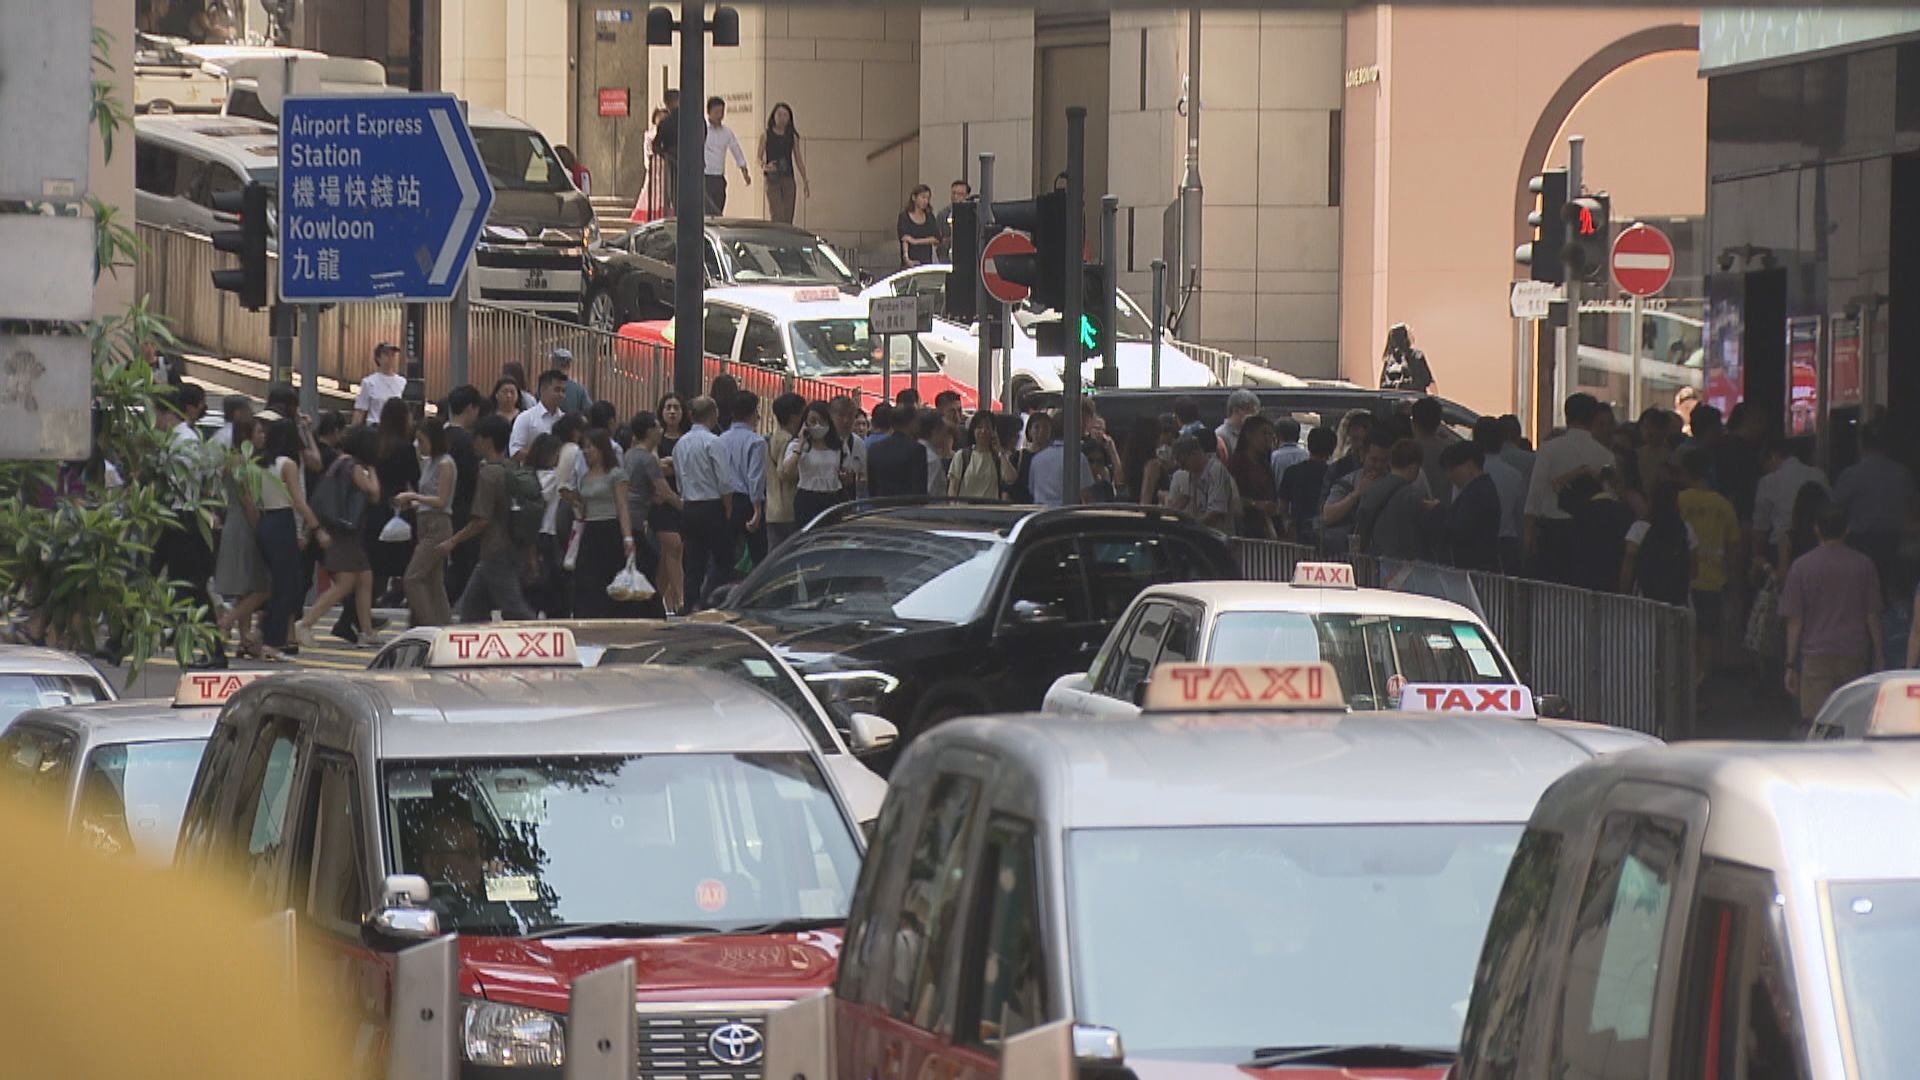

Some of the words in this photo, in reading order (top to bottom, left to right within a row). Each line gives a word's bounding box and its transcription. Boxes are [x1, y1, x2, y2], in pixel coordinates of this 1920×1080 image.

[291, 114, 350, 138] Airport
[357, 113, 422, 138] Express
[291, 142, 361, 168] Station
[292, 174, 420, 208] 機場快綫站
[290, 215, 374, 240] Kowloon
[292, 247, 340, 280] 九龍
[1615, 298, 1668, 311] BOITO
[1301, 565, 1350, 583] TAXI
[448, 630, 566, 659] TAXI
[192, 675, 258, 699] TA
[1170, 667, 1325, 704] TAXI
[1417, 688, 1521, 712] TAXI
